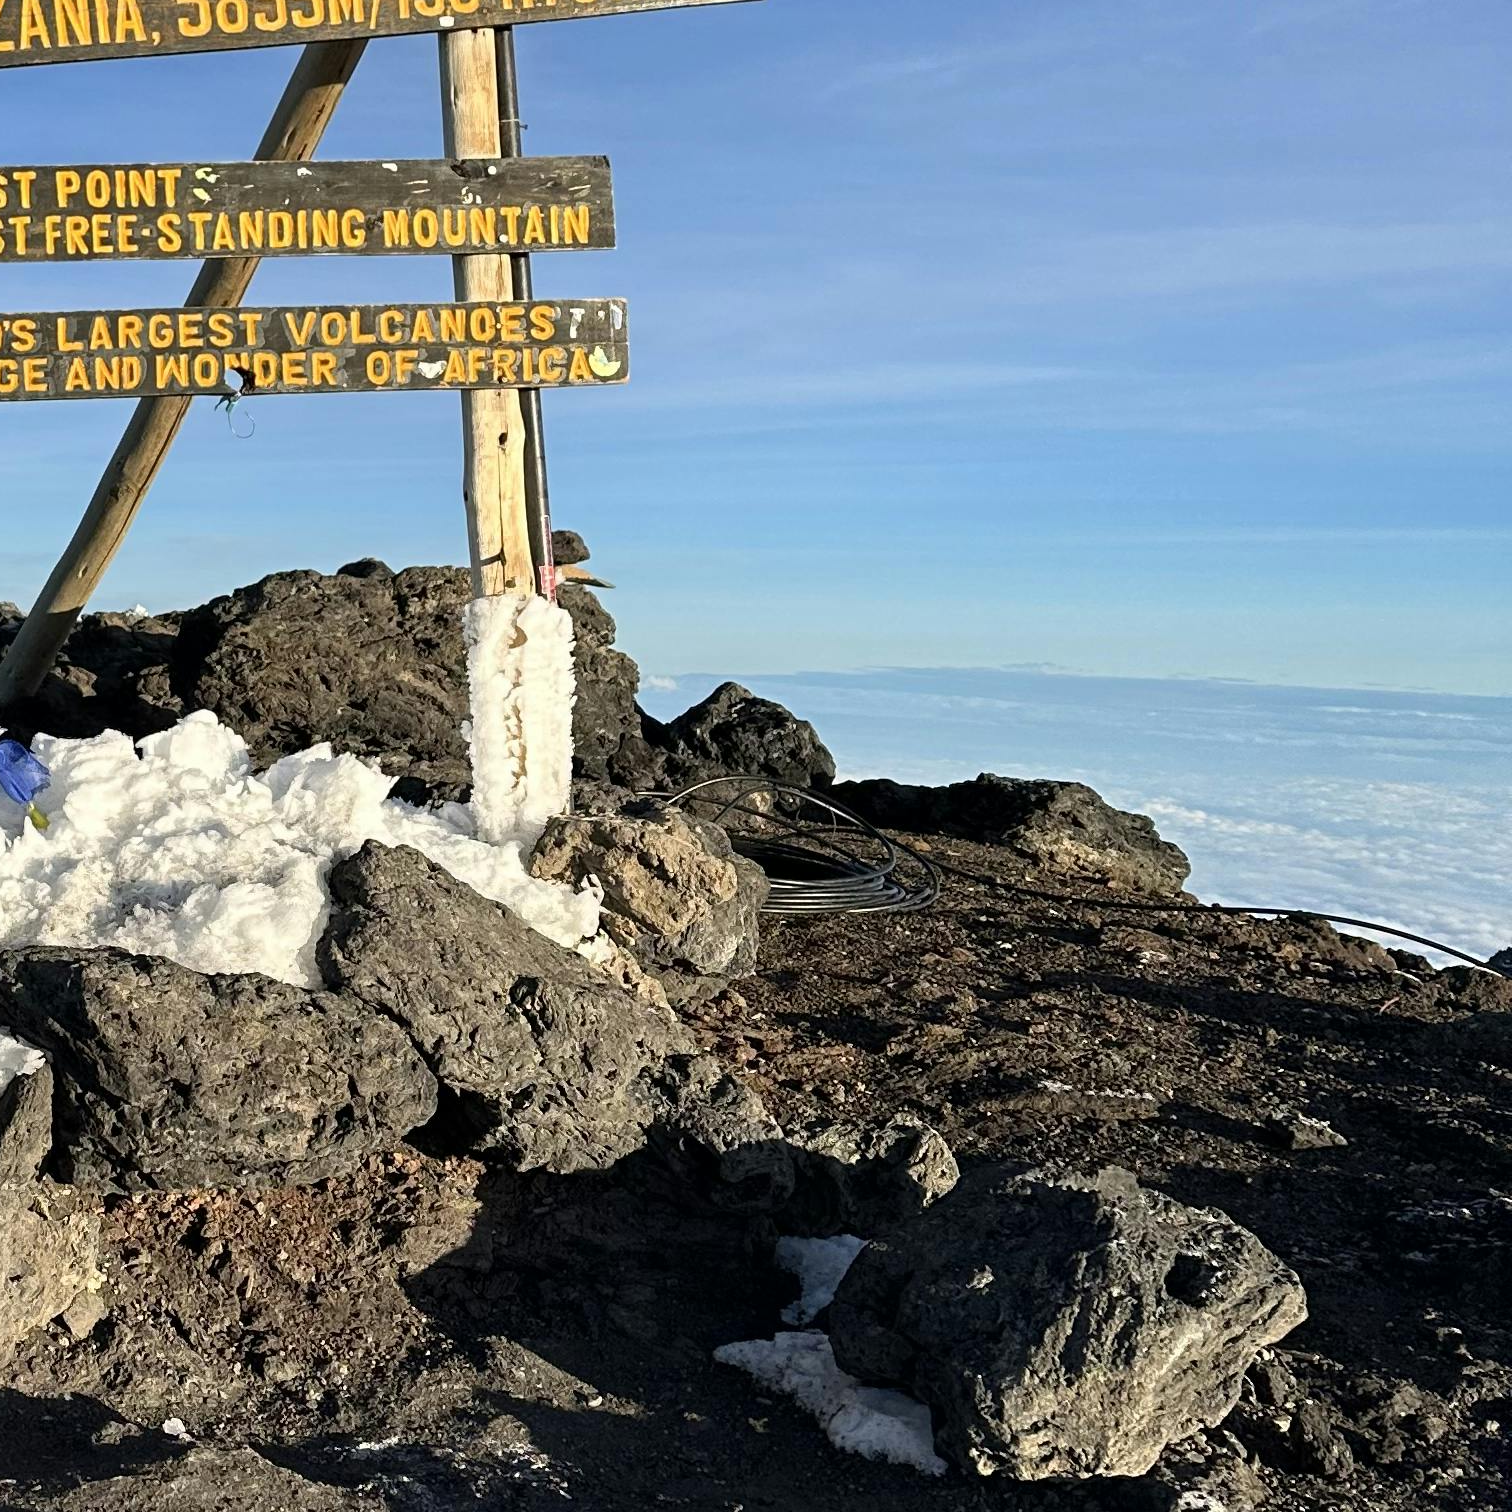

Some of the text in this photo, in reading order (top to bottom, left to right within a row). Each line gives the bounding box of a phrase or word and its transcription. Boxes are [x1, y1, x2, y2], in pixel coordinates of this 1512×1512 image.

[54, 168, 182, 209] POINT
[43, 208, 367, 254] FREE-STANDING
[382, 204, 590, 248] MOUNTAIN
[56, 312, 262, 353] LARGEST
[285, 305, 556, 347] VOLCANOES
[64, 355, 143, 391] AND
[365, 349, 419, 386] OF
[442, 346, 594, 385] AFRICA
